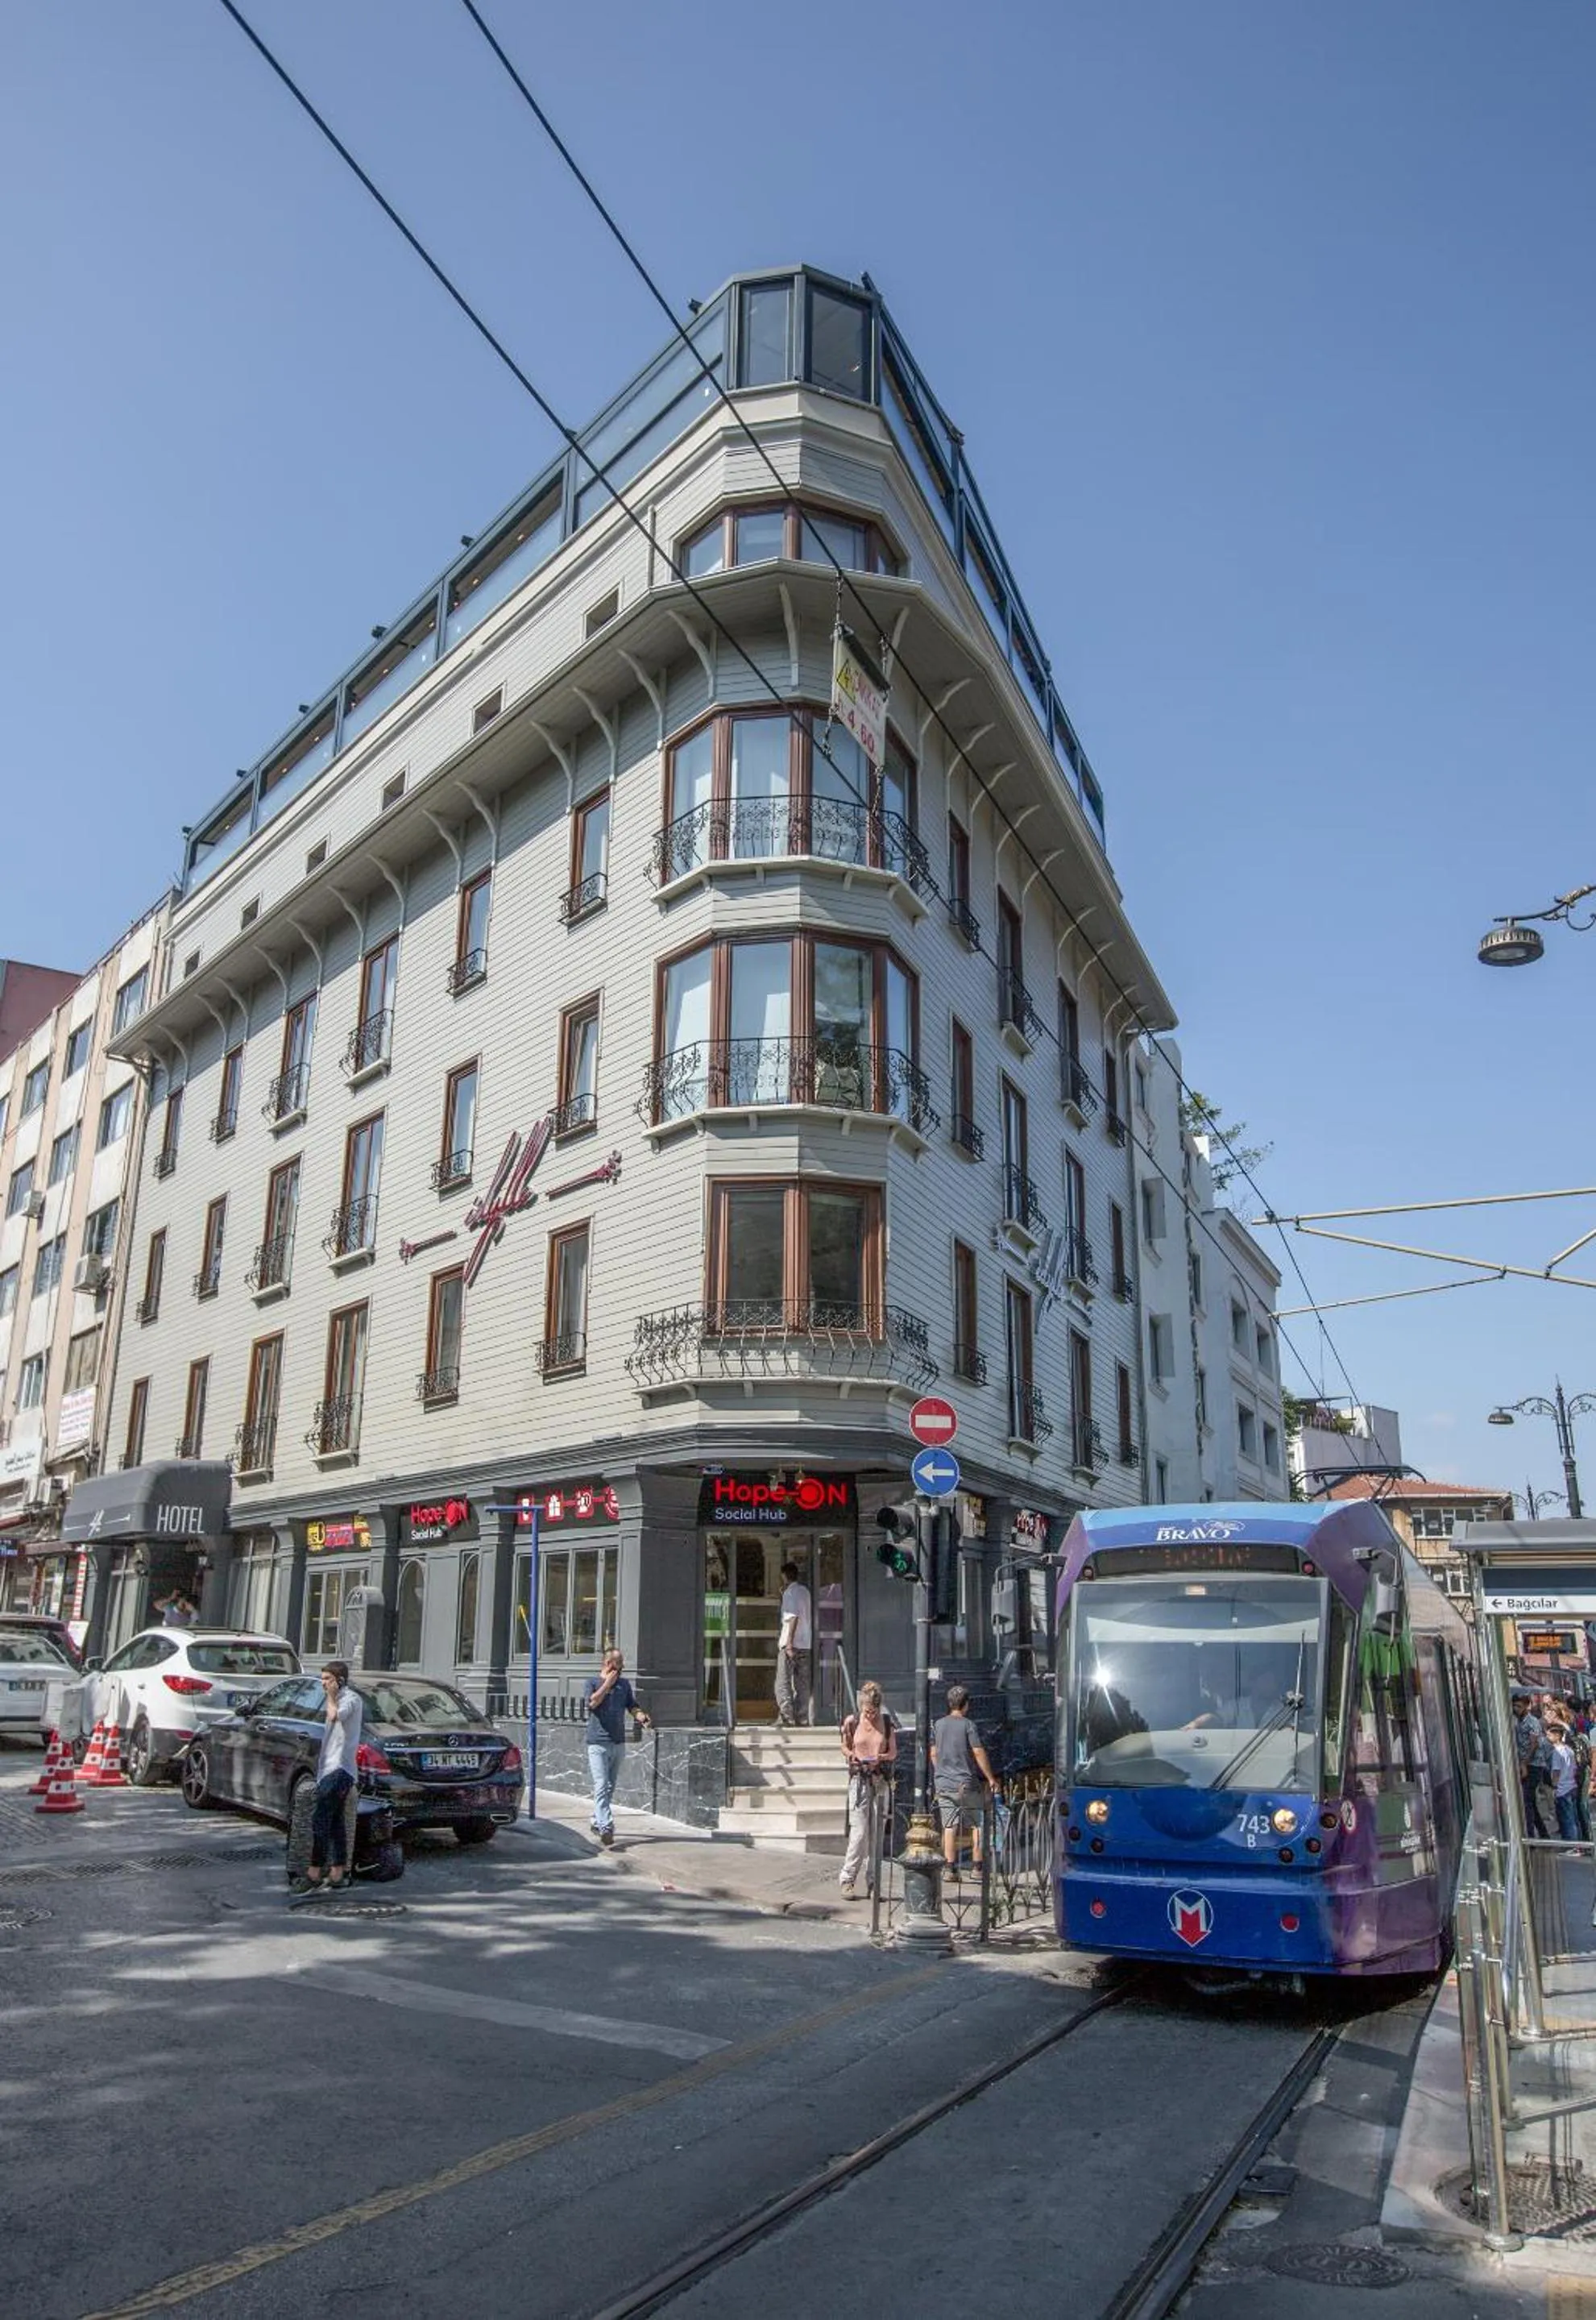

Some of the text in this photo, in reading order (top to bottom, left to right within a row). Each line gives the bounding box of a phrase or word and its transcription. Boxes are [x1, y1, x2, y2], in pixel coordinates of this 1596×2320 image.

[156, 1504, 205, 1534] HOTEL
[715, 1507, 787, 1521] Social Hub
[1156, 1526, 1231, 1542] BRAVO
[1507, 1598, 1558, 1610] Bağcılar
[1237, 1813, 1271, 1834] 743
[1247, 1833, 1257, 1848] B
